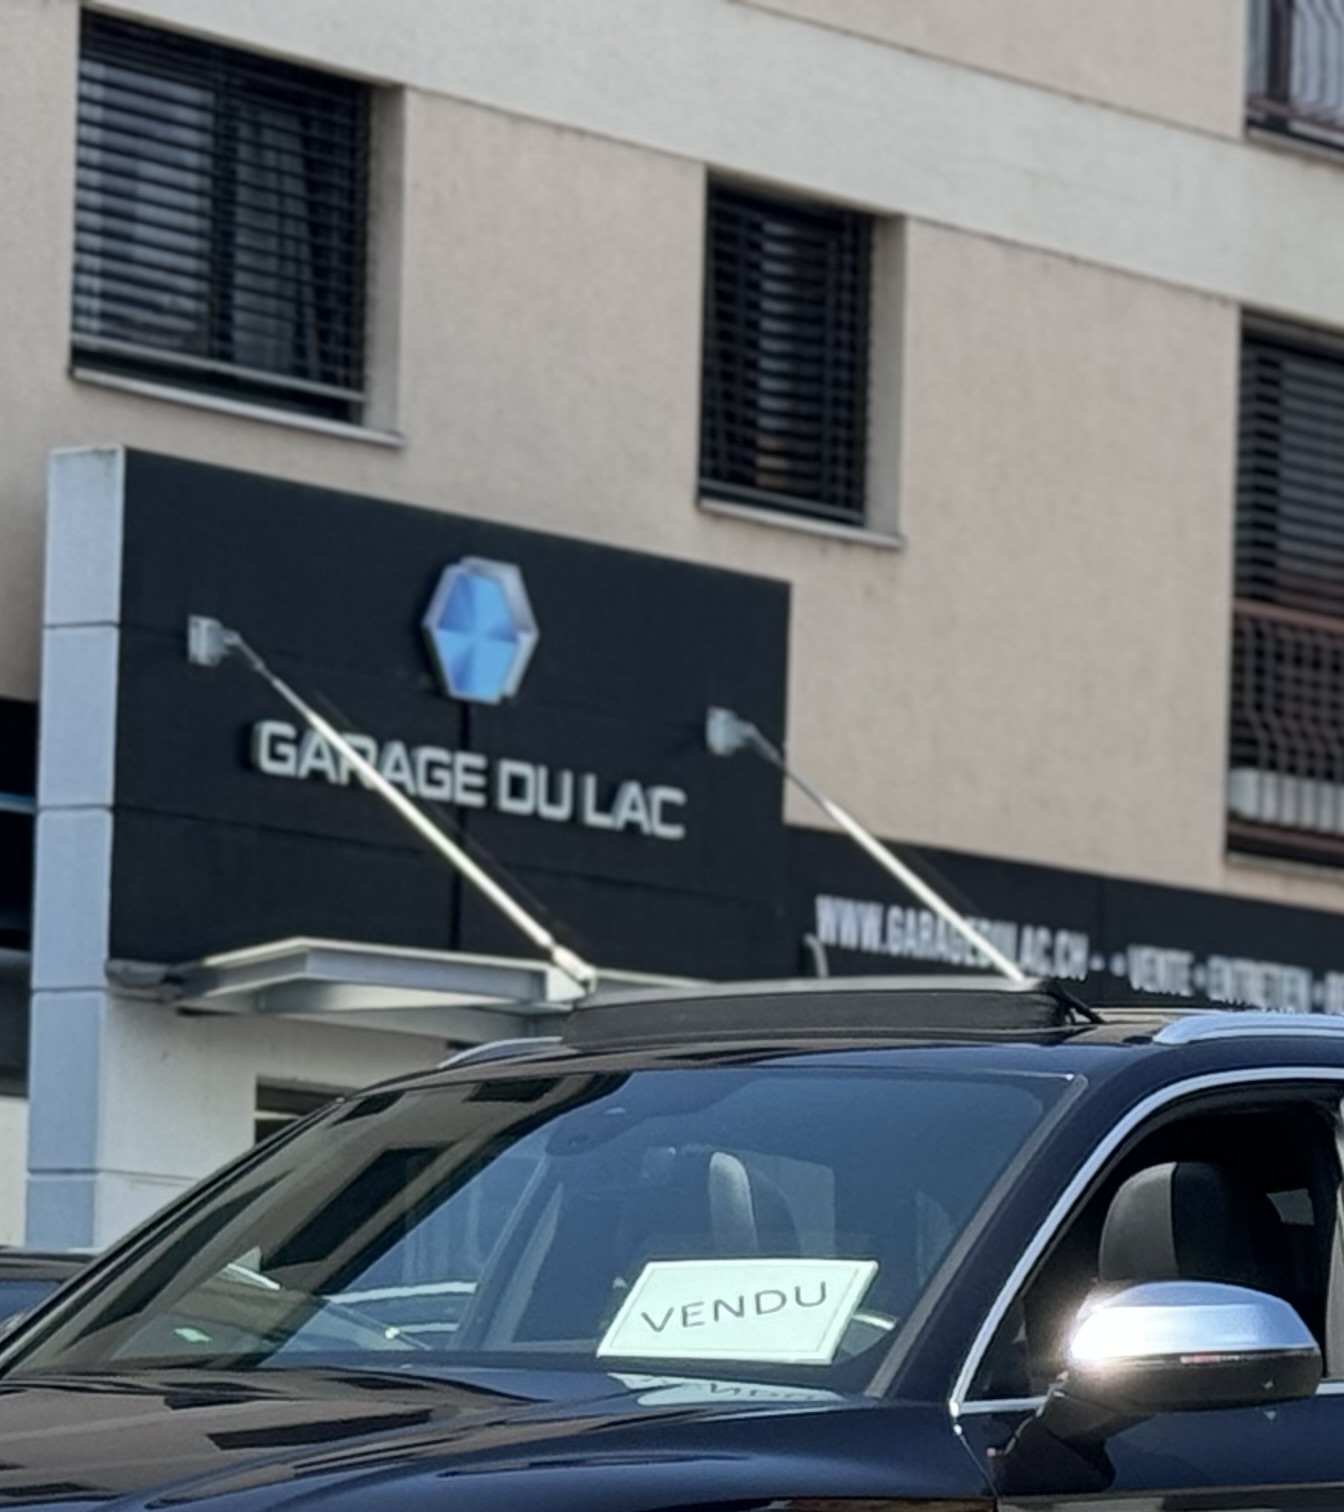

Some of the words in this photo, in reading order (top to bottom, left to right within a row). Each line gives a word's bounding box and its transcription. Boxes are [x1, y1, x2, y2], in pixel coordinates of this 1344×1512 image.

[254, 719, 488, 808] GARAGE
[497, 757, 574, 822] DU
[582, 772, 686, 840] LAC
[641, 1280, 828, 1333] VENDU
